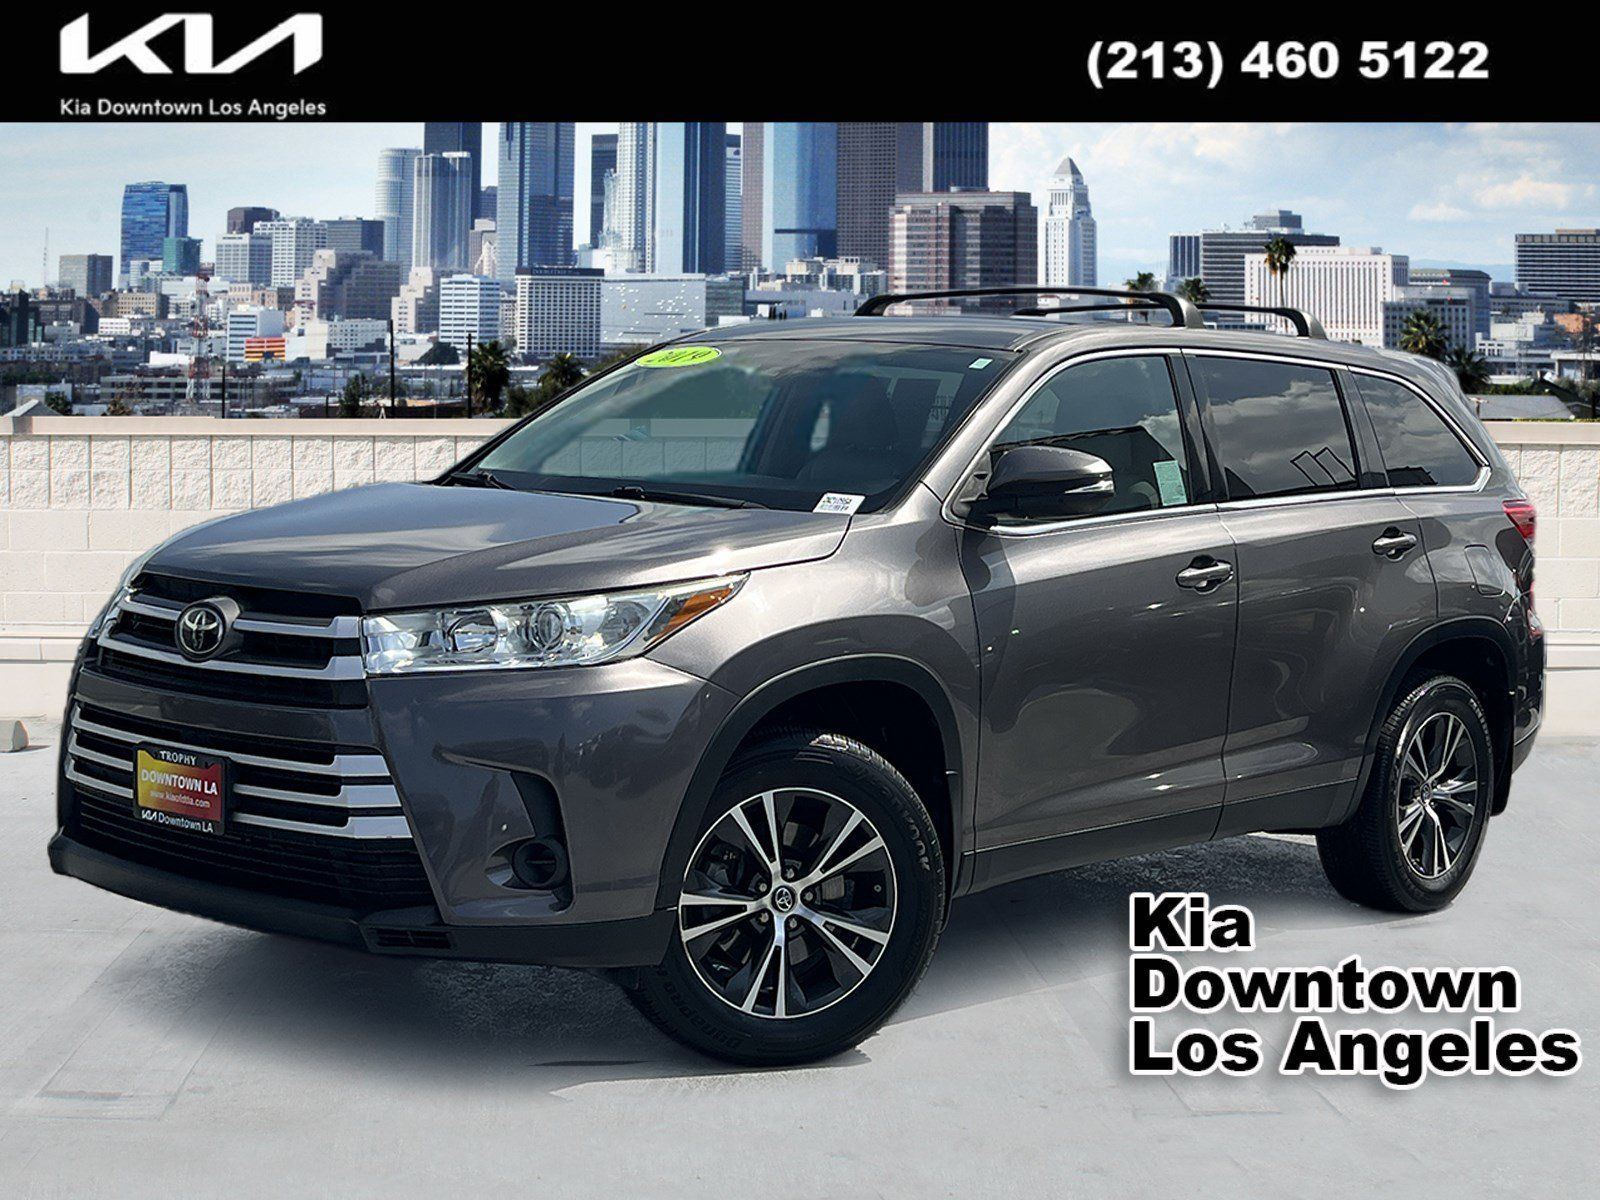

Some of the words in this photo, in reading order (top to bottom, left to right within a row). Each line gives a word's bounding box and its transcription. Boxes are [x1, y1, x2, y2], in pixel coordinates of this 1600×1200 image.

[160, 750, 197, 765] TROPHY
[141, 769, 202, 792] DOWNTOWN
[204, 781, 218, 795] LA
[158, 812, 201, 832] Downtown
[202, 821, 214, 833] LA
